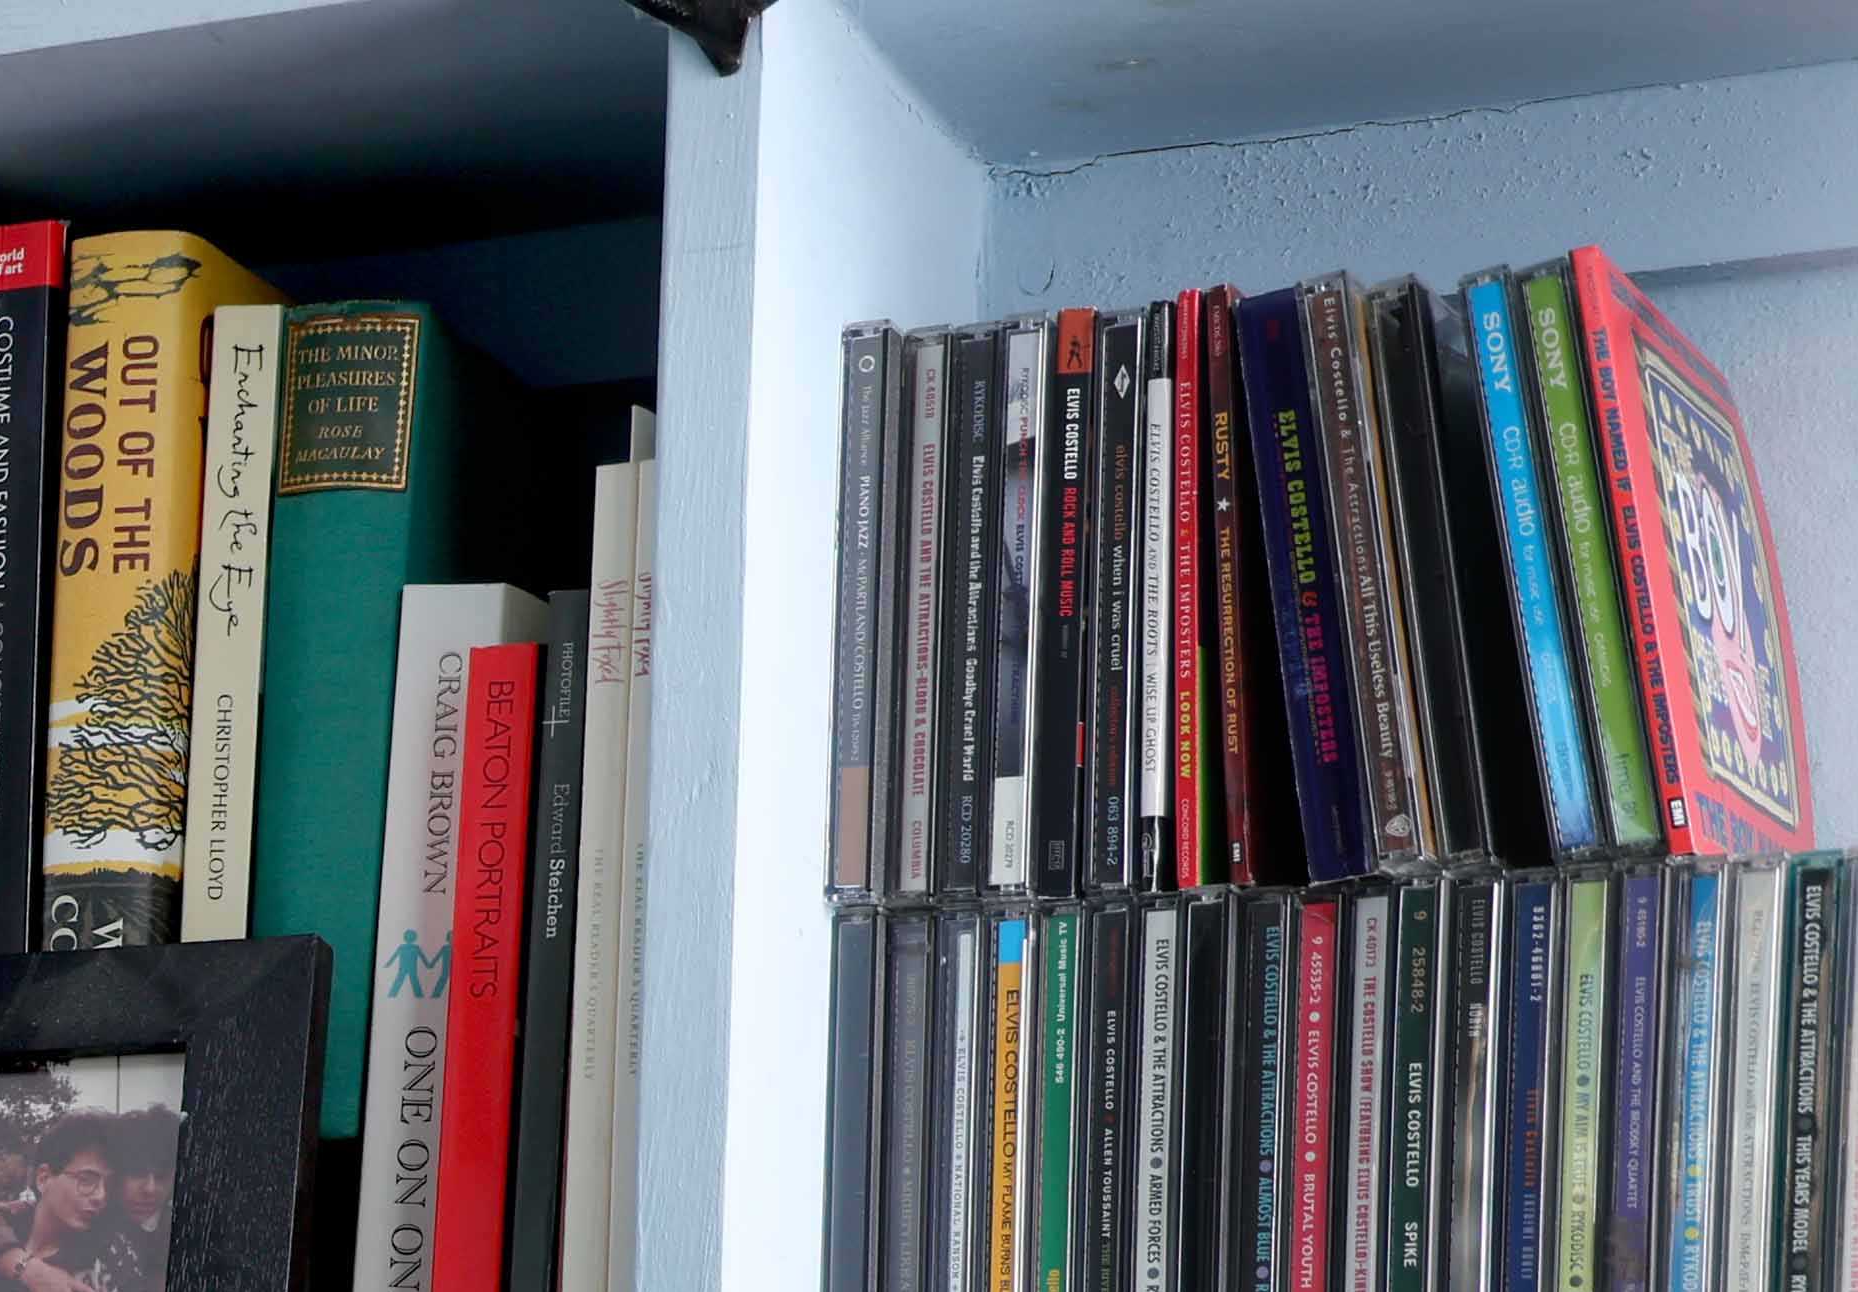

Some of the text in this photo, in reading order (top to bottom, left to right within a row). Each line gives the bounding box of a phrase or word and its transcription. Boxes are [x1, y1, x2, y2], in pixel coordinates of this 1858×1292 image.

[6, 264, 23, 275] art
[60, 342, 111, 578] WOODS
[112, 334, 160, 573] OUT OF THE
[209, 343, 264, 638] Enchanting the Eye
[1212, 411, 1240, 754] RUSTY THE RESURRECTION OF RUST
[207, 693, 234, 901] CHRISTOPHER LLOYD
[423, 650, 463, 896] CRAIG BROWN
[469, 679, 516, 999] BEATON PORTRAITS
[546, 783, 571, 940] Edward Steichen
[394, 1142, 430, 1209] ON
[398, 1024, 437, 1127] ONE
[1301, 1029, 1321, 1288] ELVIS COSTELLO BRUTAL YOUTH
[1404, 1063, 1423, 1268] ELVIS COSTELLO SPIKE
